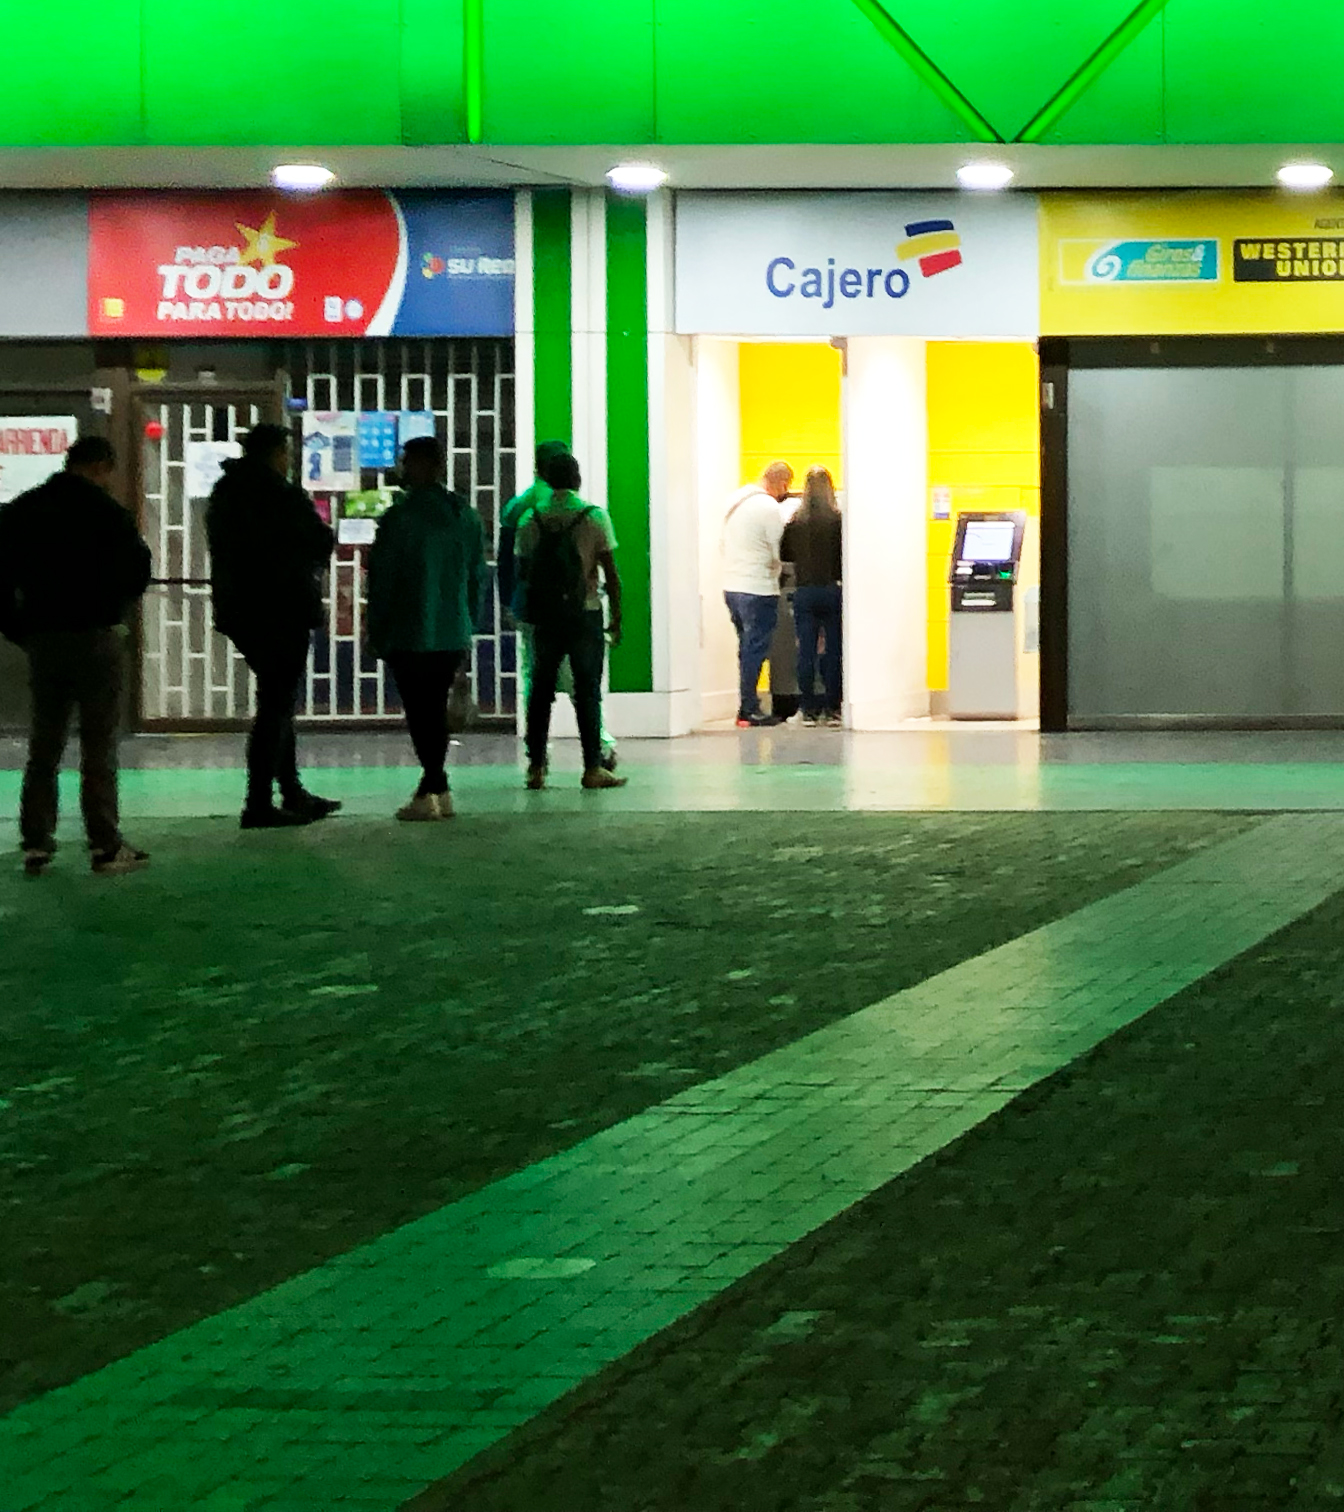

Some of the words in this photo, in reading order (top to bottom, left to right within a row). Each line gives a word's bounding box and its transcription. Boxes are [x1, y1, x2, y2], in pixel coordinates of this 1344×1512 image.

[174, 245, 240, 265] PAGA
[156, 263, 295, 300] TODO
[766, 256, 911, 309] Cajero
[156, 300, 222, 321] PARA
